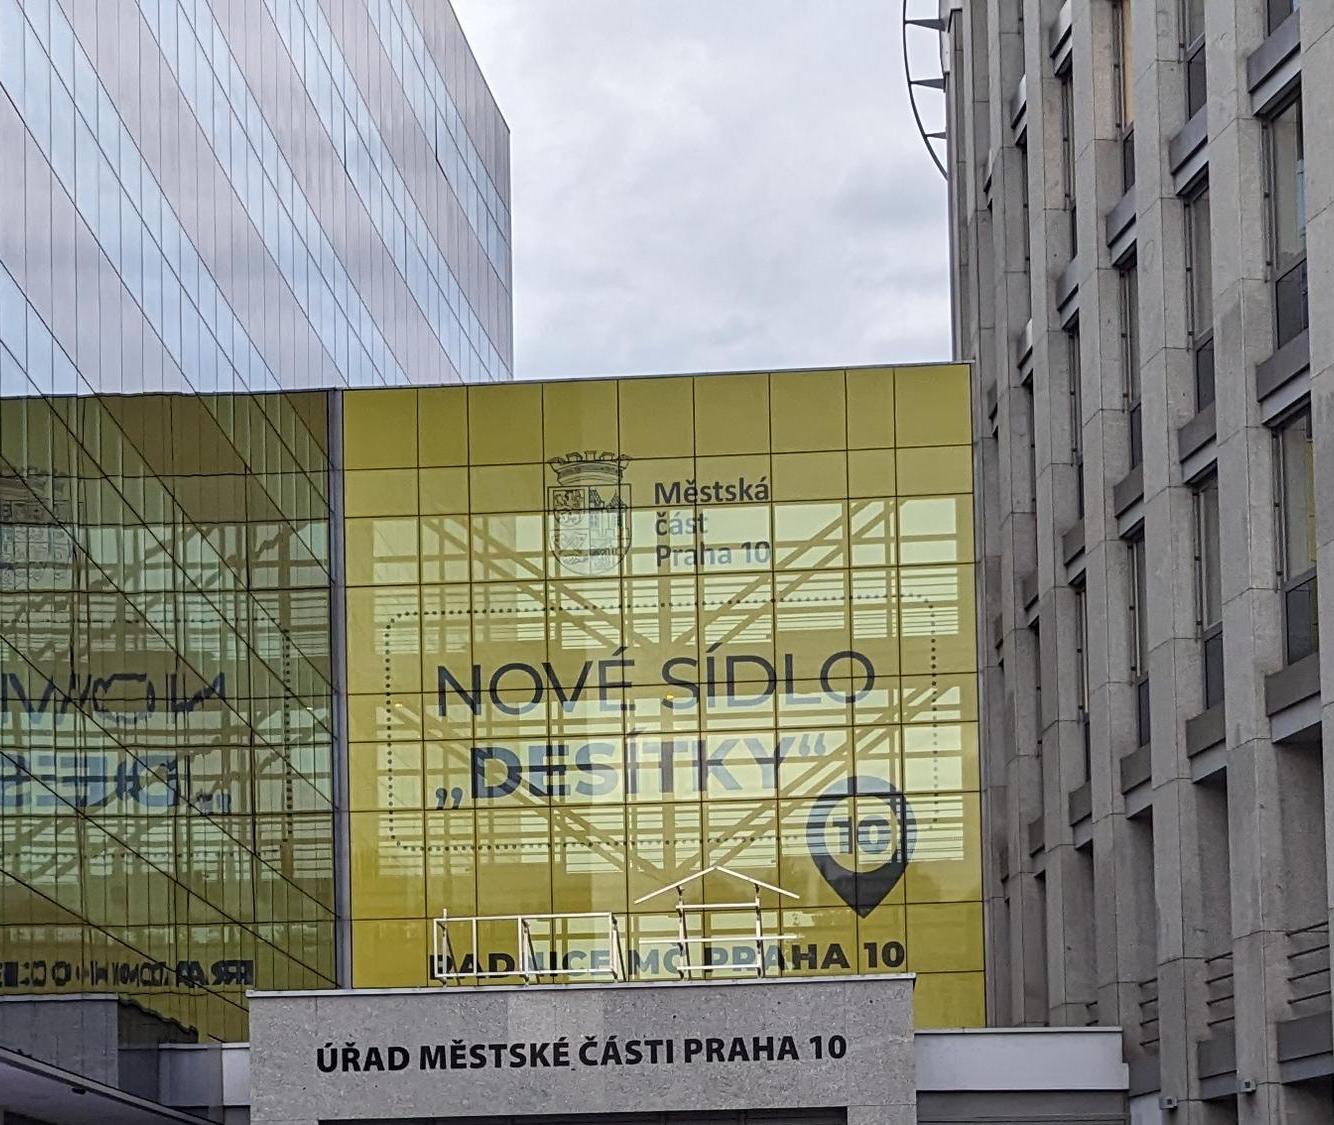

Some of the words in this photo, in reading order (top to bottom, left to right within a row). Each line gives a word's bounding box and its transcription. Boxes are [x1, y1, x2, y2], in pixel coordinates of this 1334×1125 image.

[654, 476, 769, 505] Městská
[655, 511, 709, 536] část
[656, 541, 732, 567] Praha
[741, 541, 771, 564] 10
[438, 646, 636, 717] NOVÉ
[661, 641, 876, 710] SÍDLO
[831, 815, 892, 855] 10
[704, 942, 851, 975] PRAHA
[863, 941, 905, 969] 10
[316, 1042, 411, 1073] ÚŘAD
[419, 1037, 570, 1070] MĚSTSKÉ
[578, 1035, 674, 1066] ČÁSTI
[684, 1035, 800, 1064] PRAHA
[808, 1034, 847, 1060] 10
